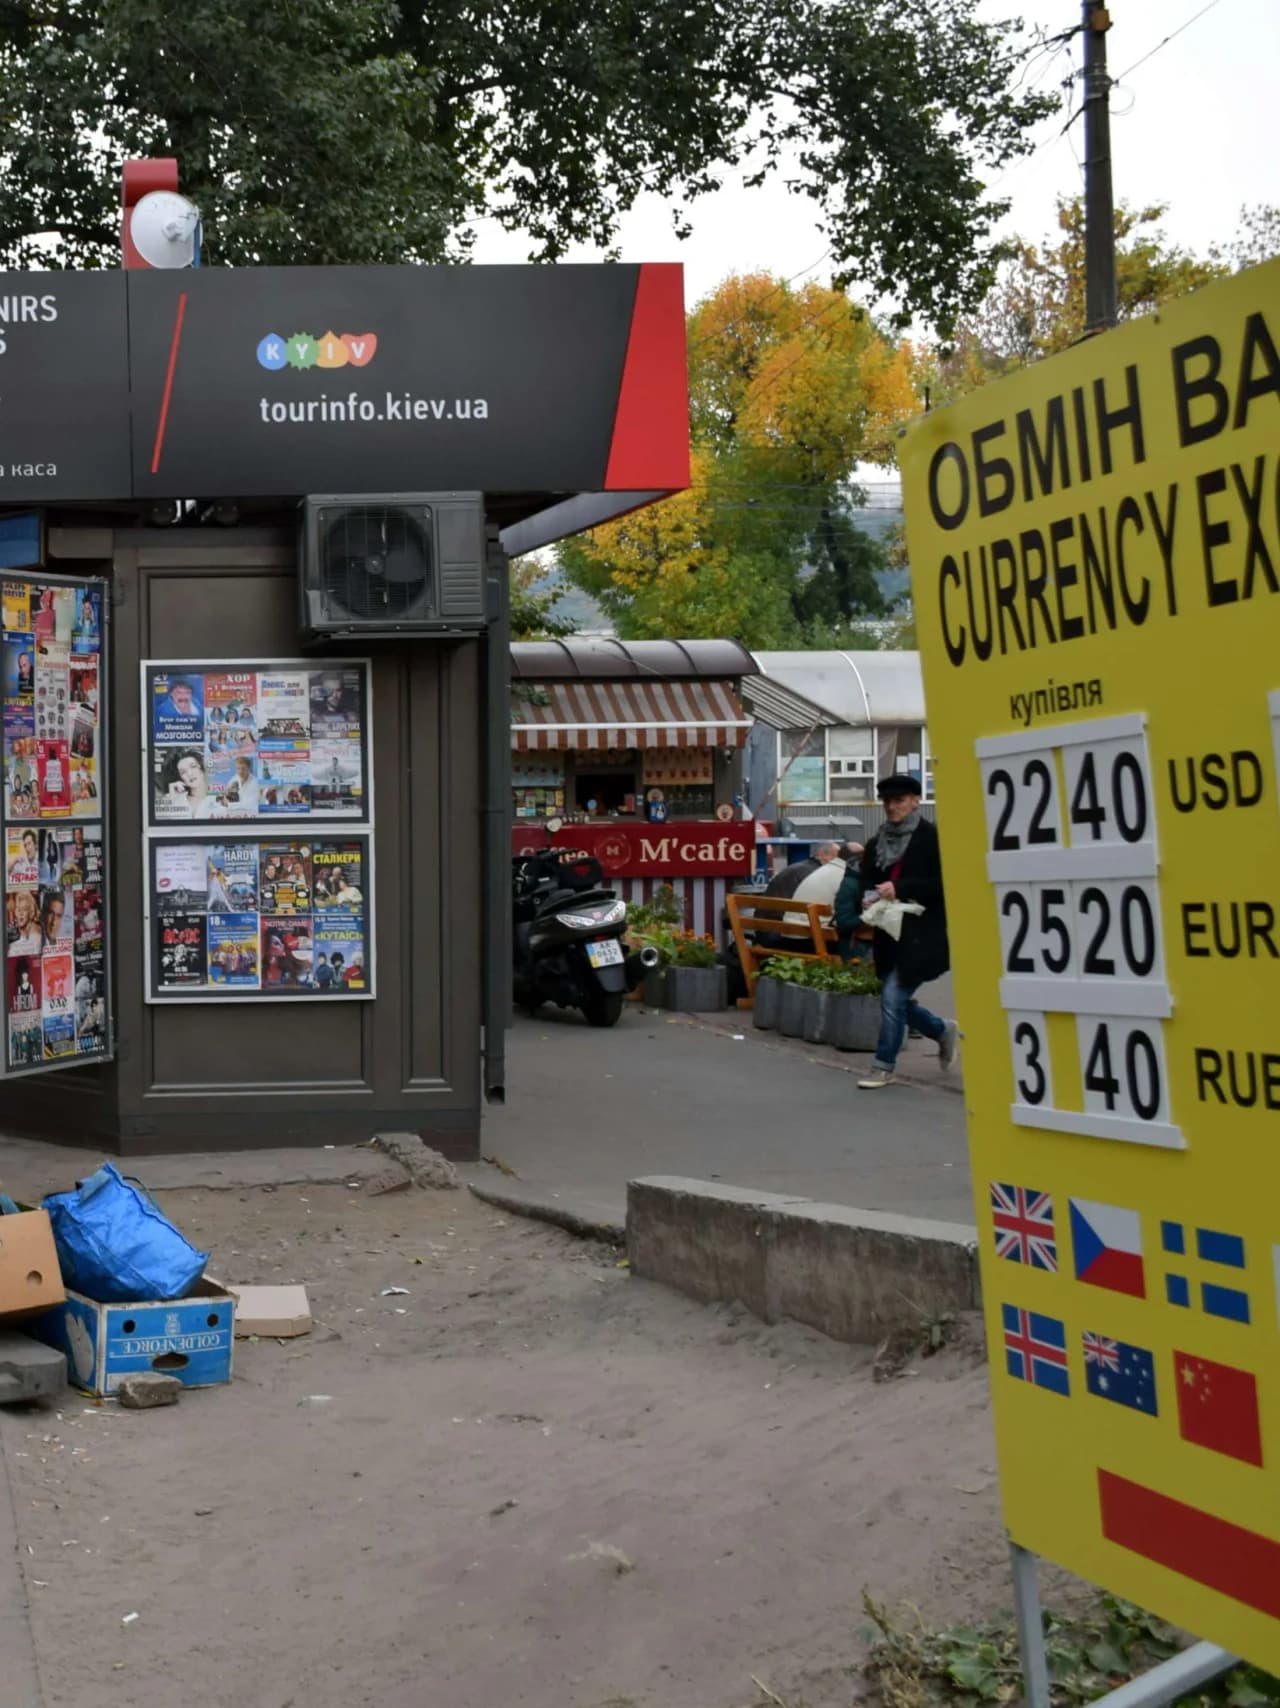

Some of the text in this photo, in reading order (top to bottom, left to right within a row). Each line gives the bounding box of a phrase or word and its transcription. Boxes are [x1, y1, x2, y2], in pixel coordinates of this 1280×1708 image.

[260, 392, 489, 423] tourinfo.kiev.ua
[928, 363, 1146, 531] ОБМІН
[12, 463, 57, 476] каса
[938, 454, 1280, 667] CURRENCY EX
[1009, 678, 1104, 726] купівля
[1168, 750, 1264, 813] USD
[224, 850, 253, 861] HARDY
[313, 853, 361, 864] СТАЛКЕРИ
[640, 837, 745, 863] M'cafe
[1181, 902, 1280, 959] EUR
